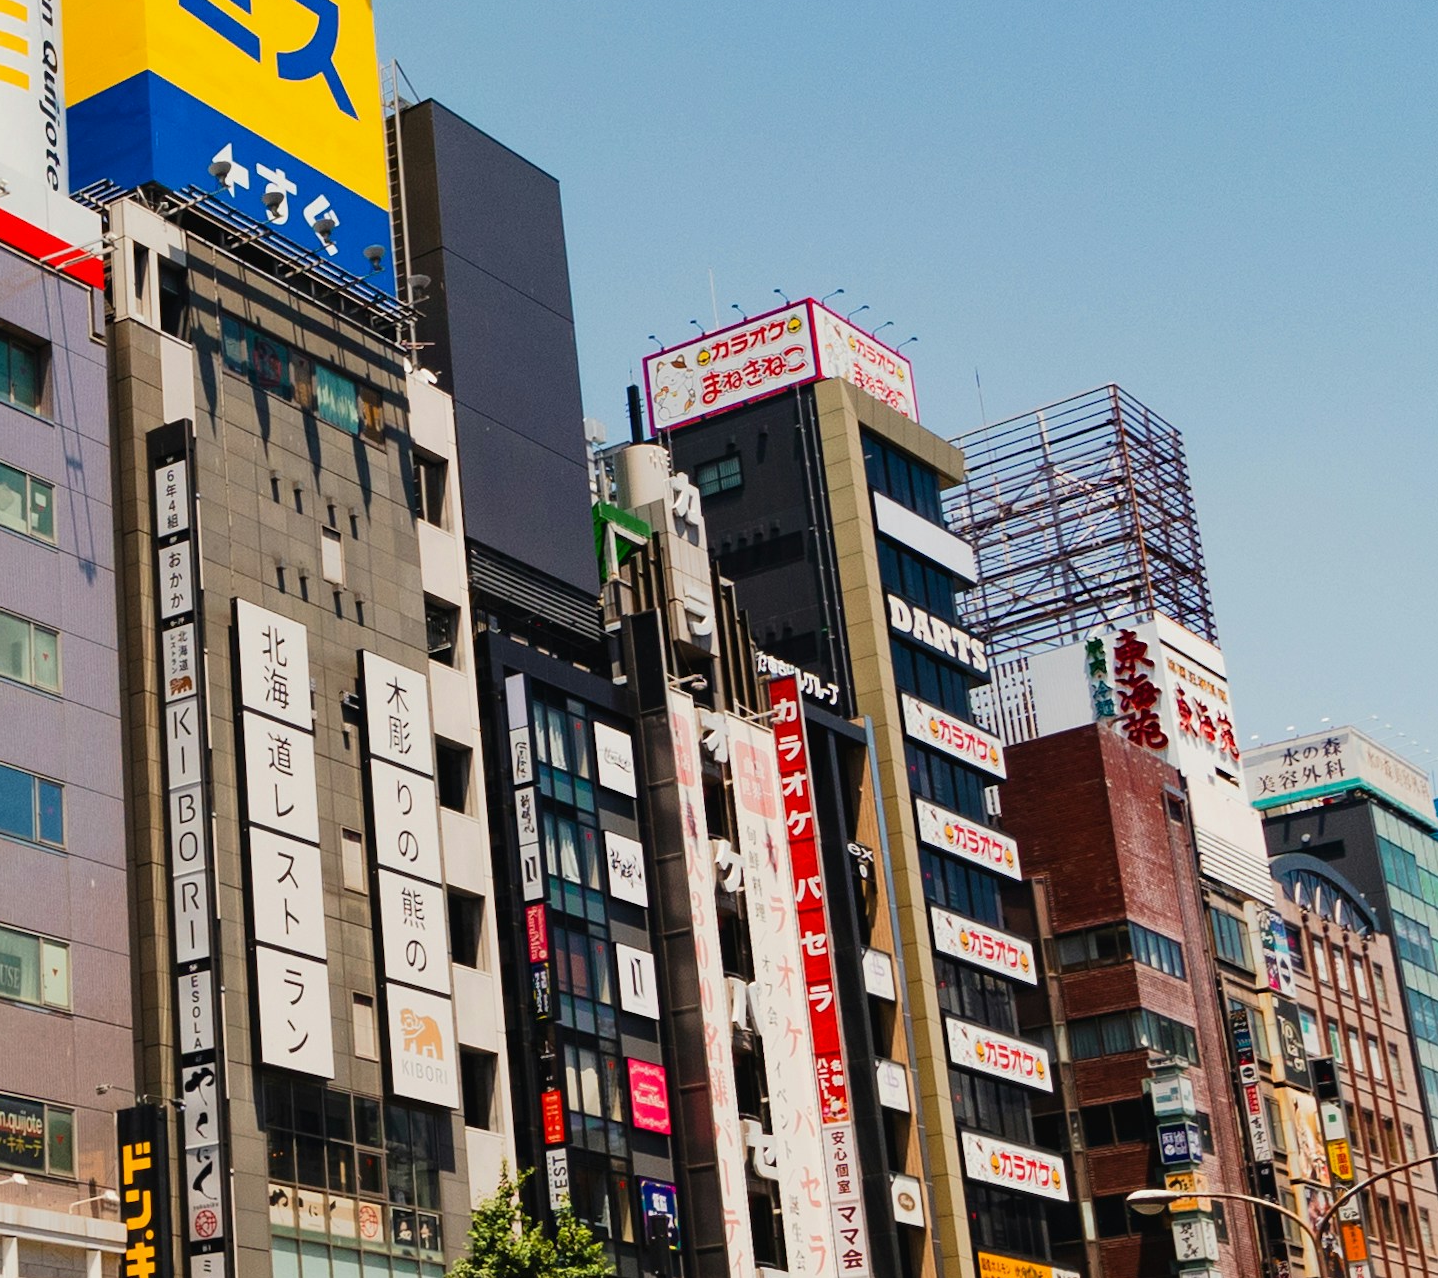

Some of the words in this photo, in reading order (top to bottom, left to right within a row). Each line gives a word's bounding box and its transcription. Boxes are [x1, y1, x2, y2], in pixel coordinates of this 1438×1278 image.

[40, 39, 61, 194] Quijote
[710, 320, 789, 364] カラオケ
[848, 333, 898, 379] カラオケ
[700, 346, 808, 407] まねきねこ
[887, 593, 989, 676] DARTS
[937, 713, 993, 764] カラオケ
[1280, 737, 1342, 767] 水の森
[1255, 759, 1346, 796] 美容外科
[172, 709, 201, 951] KIBORI
[260, 624, 311, 1056] 北海道レストラン
[384, 675, 429, 974] 木彫りの熊の
[951, 820, 1005, 868] カラオケ
[770, 698, 813, 836] カラオケ
[794, 875, 834, 1013] パセラ
[966, 928, 1020, 971] カラオケ
[189, 973, 204, 1051] ESOLA
[400, 1060, 450, 1086] KIBORI
[982, 1036, 1037, 1079] カラオケ
[831, 1130, 852, 1196] 安心個室
[996, 1151, 1052, 1191] カラオケ
[835, 1205, 864, 1271] ママ会
